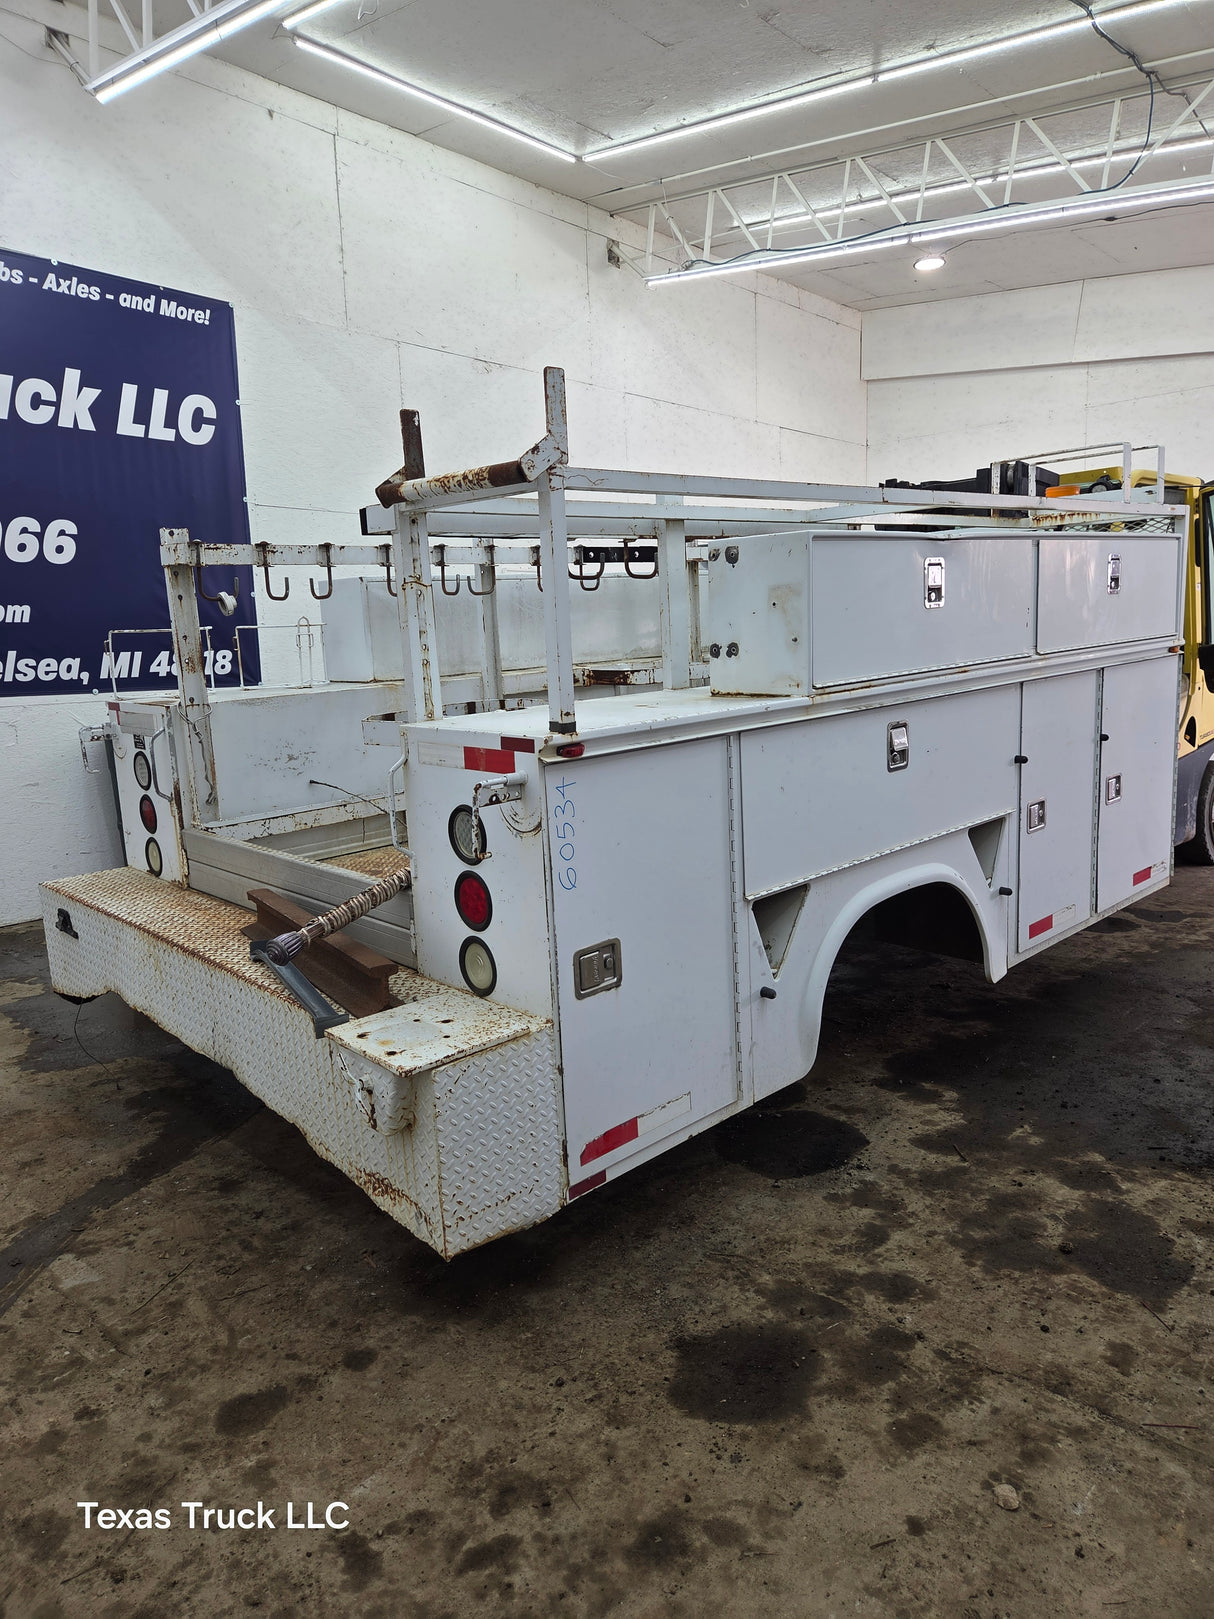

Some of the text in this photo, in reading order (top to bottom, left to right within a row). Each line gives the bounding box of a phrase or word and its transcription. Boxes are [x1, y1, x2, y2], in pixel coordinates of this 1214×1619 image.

[42, 272, 101, 301] Axles
[119, 292, 156, 313] and
[159, 298, 211, 325] More!
[116, 382, 217, 446] LLC
[0, 516, 78, 565] 66
[0, 649, 233, 685] lsea, MI 418
[554, 776, 577, 890] 60534
